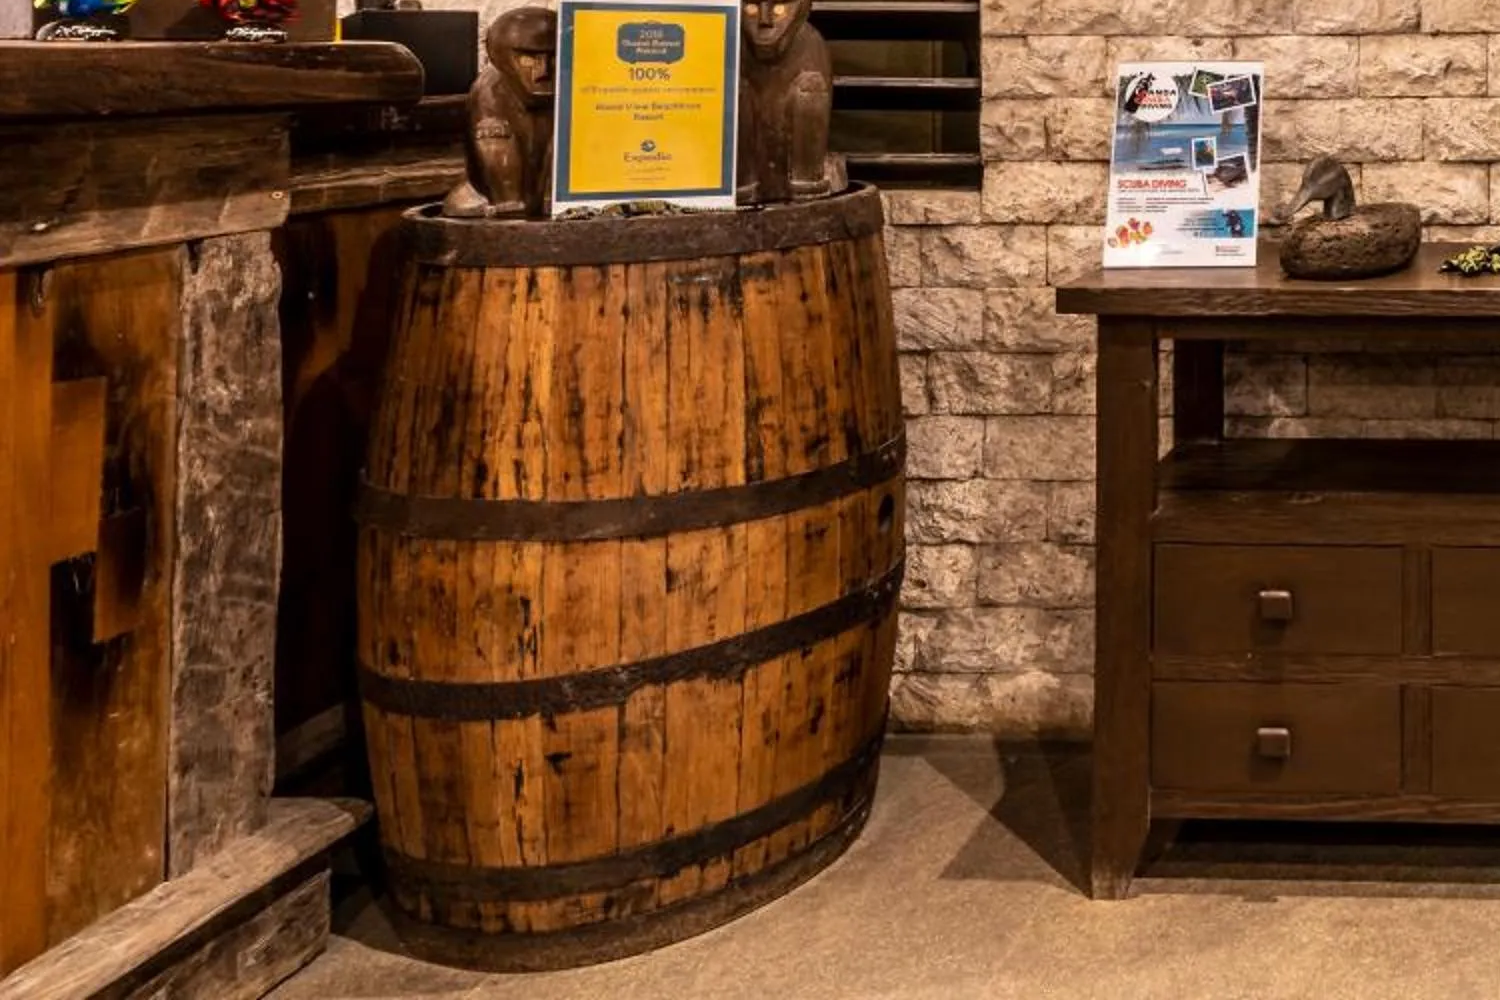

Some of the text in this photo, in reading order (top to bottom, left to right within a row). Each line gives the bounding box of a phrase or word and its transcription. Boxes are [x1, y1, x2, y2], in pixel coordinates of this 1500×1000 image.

[629, 67, 672, 81] 100%
[1118, 179, 1187, 189] SCUBA DIVING
